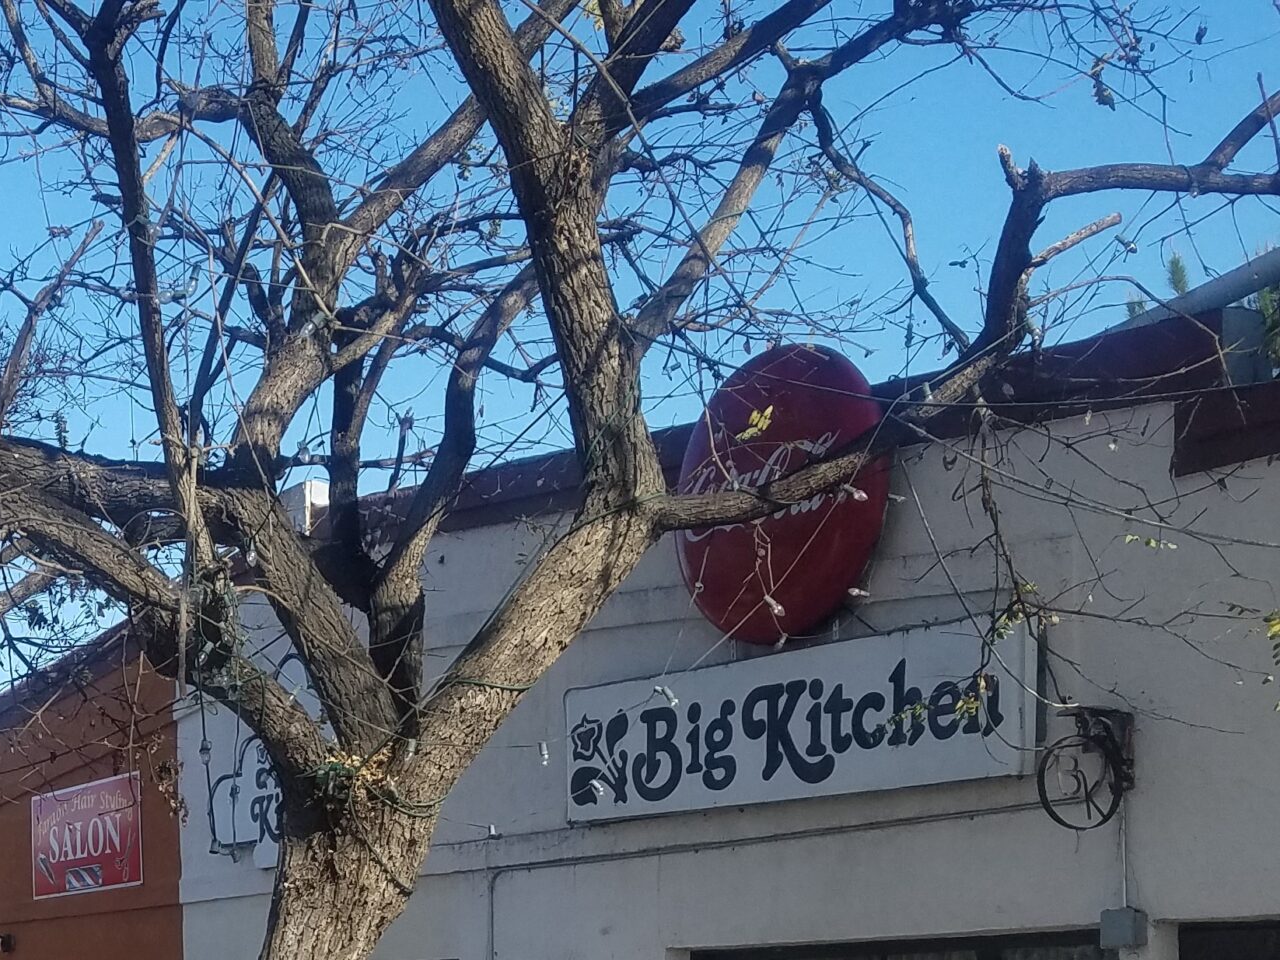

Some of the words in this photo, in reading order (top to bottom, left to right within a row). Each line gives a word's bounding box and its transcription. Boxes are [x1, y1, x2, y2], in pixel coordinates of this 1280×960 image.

[631, 698, 737, 803] Big
[741, 657, 1005, 785] Kitchen
[70, 789, 97, 812] Hair
[49, 813, 122, 863] SALON
